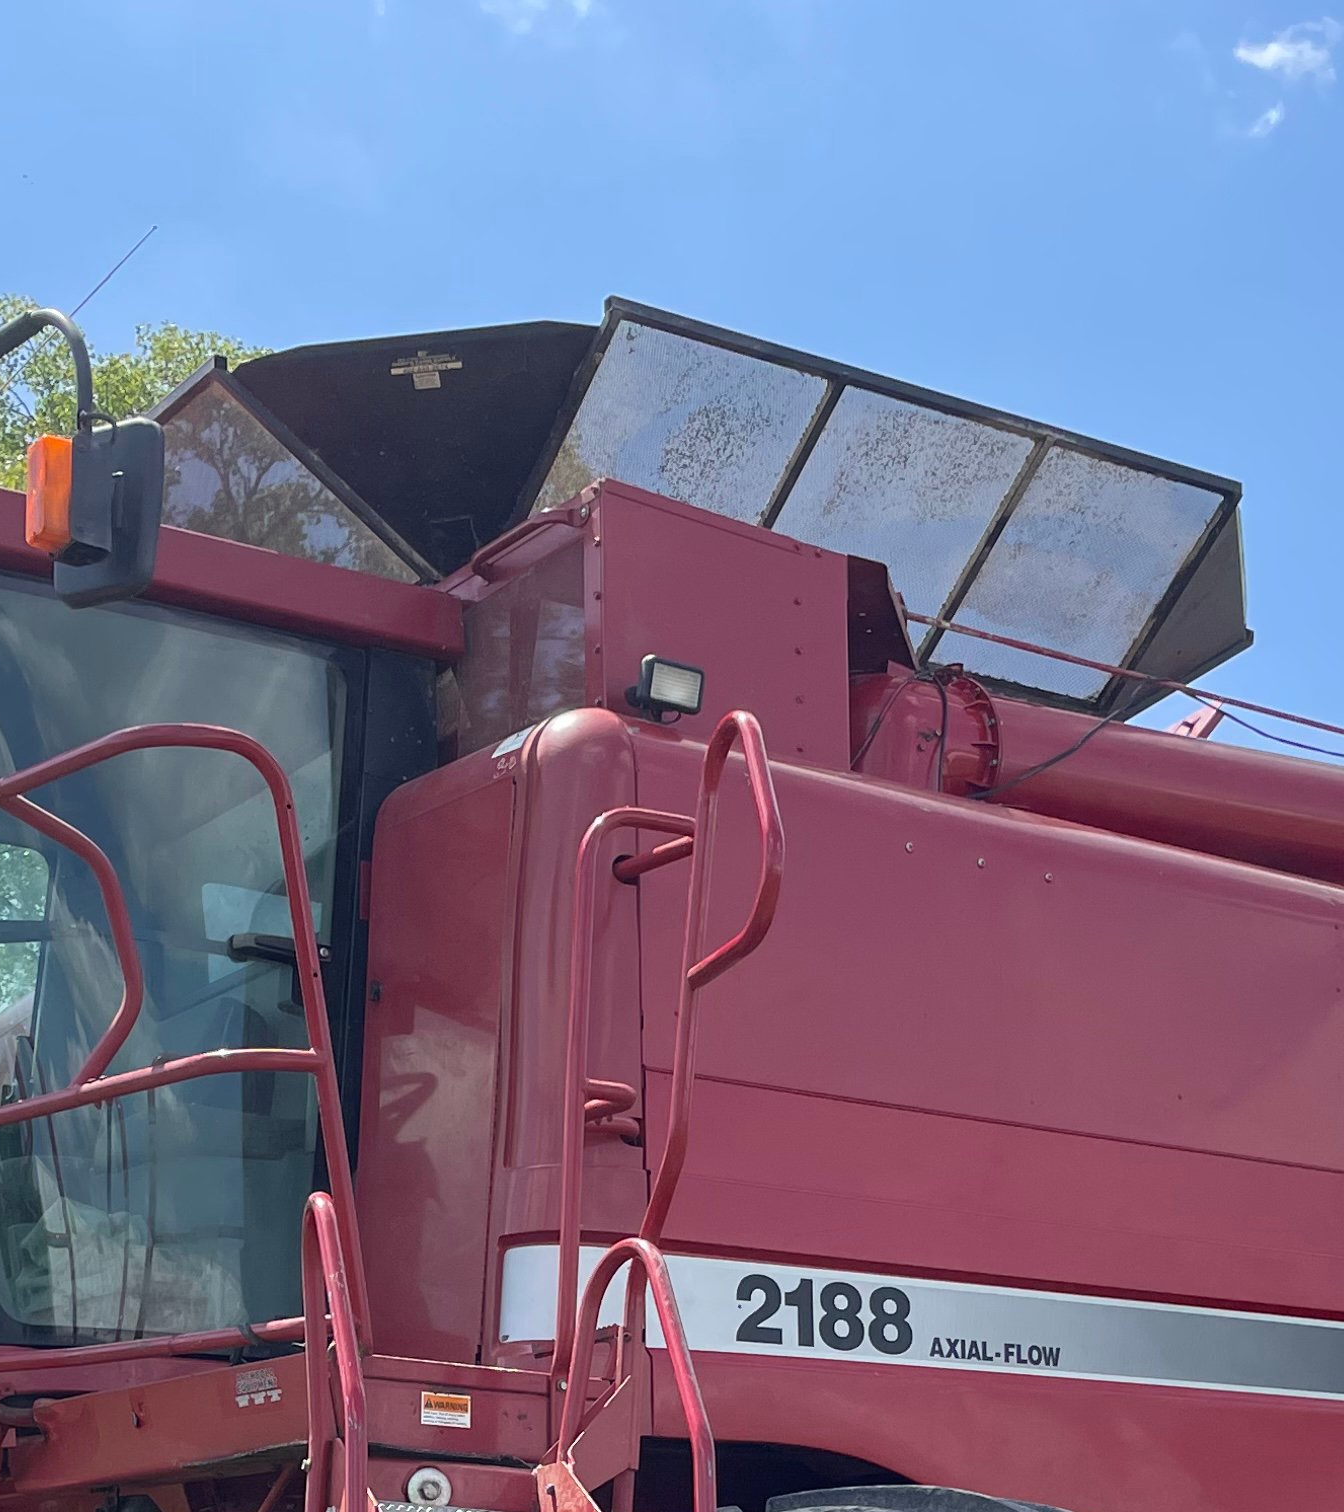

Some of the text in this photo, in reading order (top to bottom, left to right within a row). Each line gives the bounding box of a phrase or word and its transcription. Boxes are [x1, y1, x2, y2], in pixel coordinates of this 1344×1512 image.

[736, 1274, 913, 1355] 2188
[929, 1337, 1061, 1367] AXIAL-FLOW
[433, 1400, 468, 1413] WARNING
